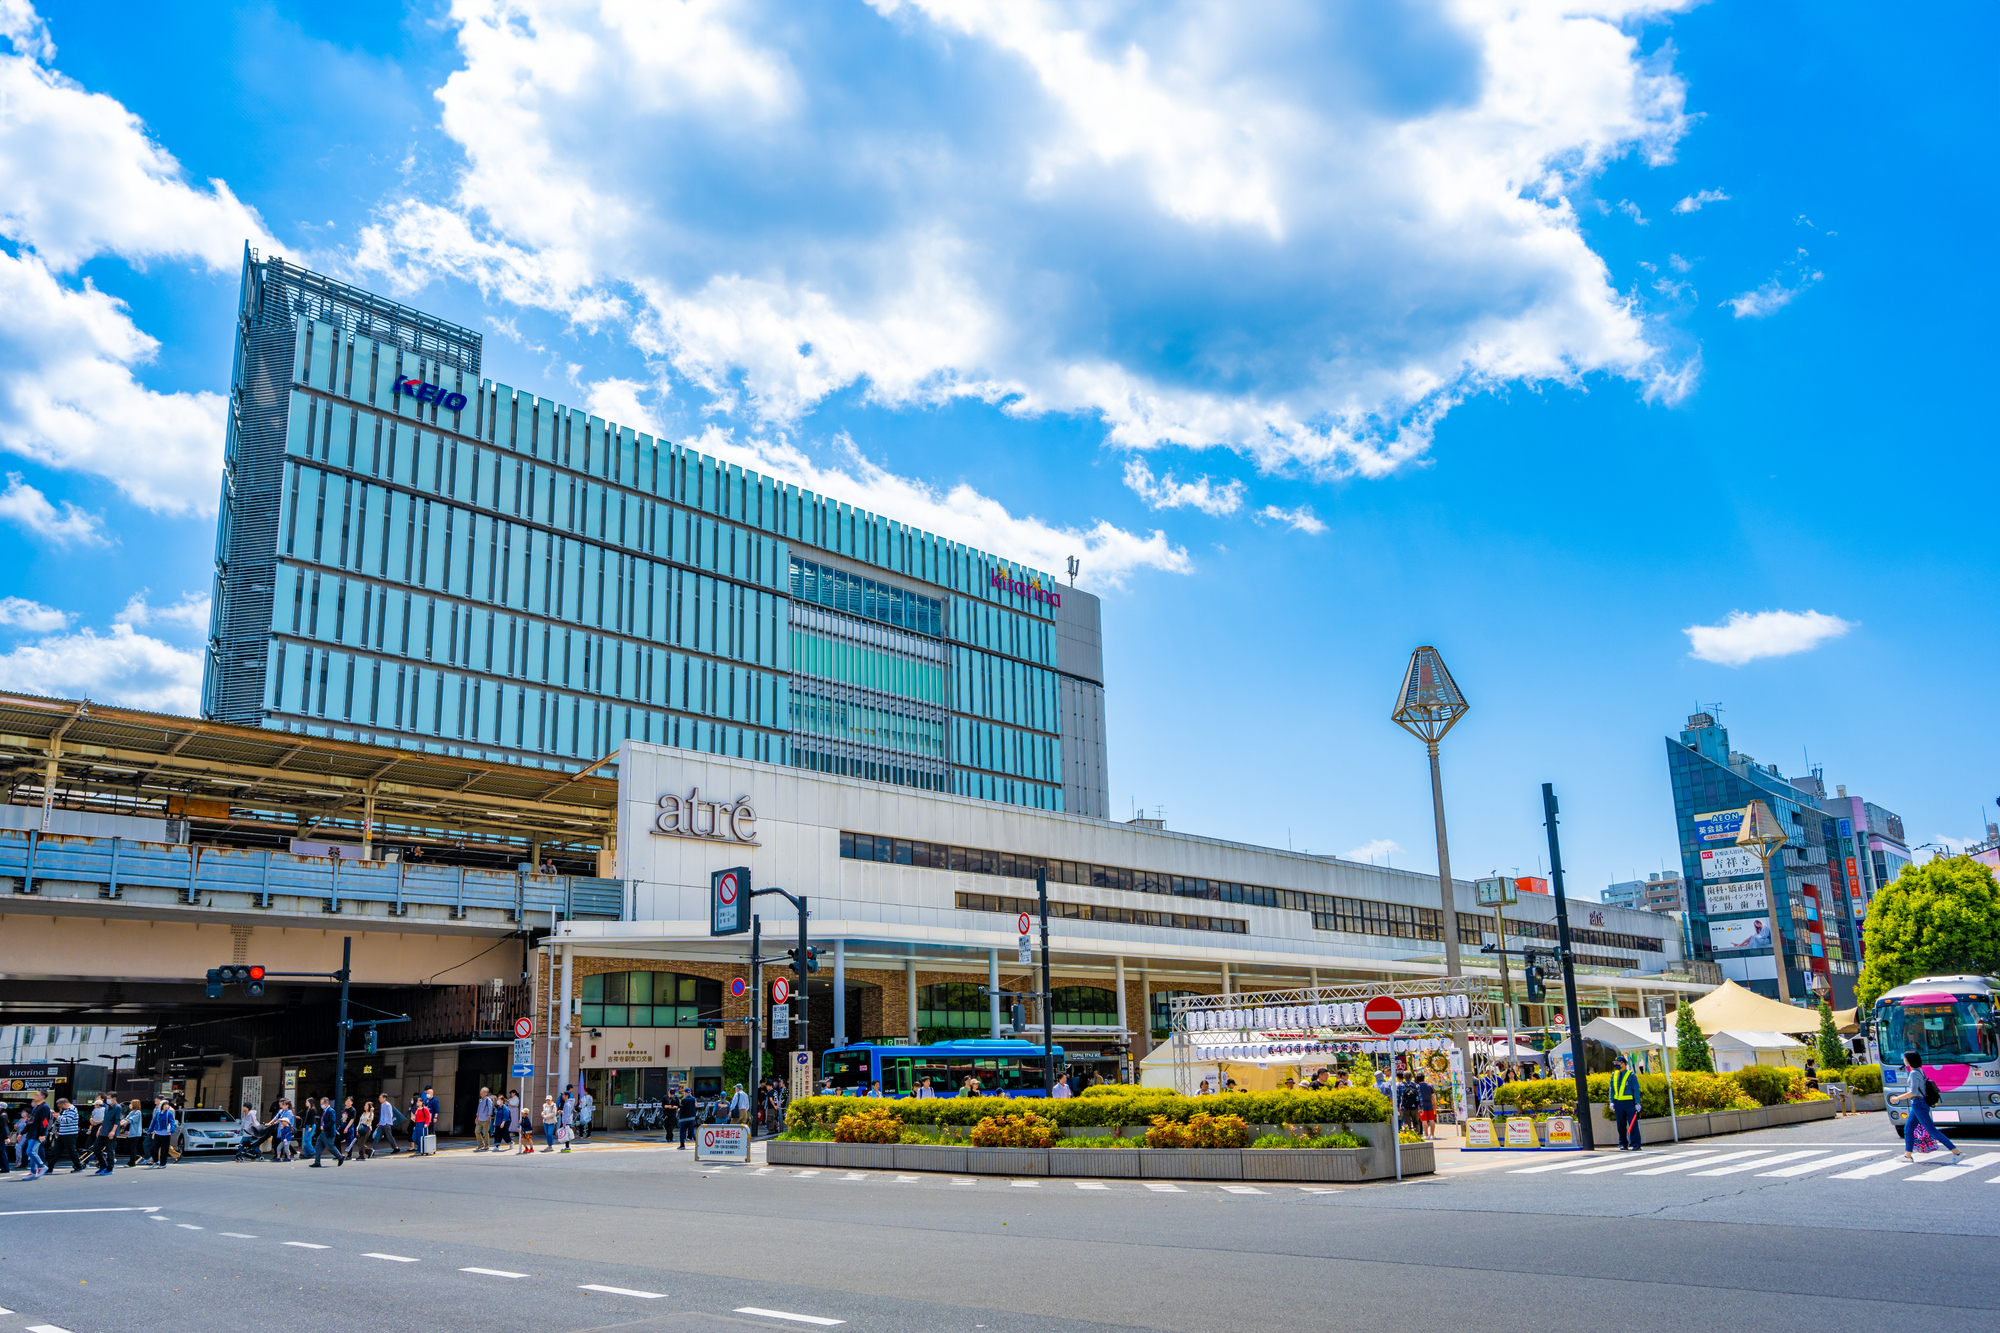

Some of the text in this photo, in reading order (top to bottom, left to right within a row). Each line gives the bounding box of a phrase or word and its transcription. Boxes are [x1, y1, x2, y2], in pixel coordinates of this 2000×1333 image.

[392, 374, 468, 412] KEIO
[991, 566, 1061, 608] kirarina
[656, 786, 758, 842] atré
[1712, 812, 1740, 823] AEON
[1713, 856, 1750, 870] 吉祥寺
[1705, 866, 1761, 878] セントラルクリニック
[9, 1068, 45, 1077] kirarina
[715, 1130, 741, 1139] 車両通行止
